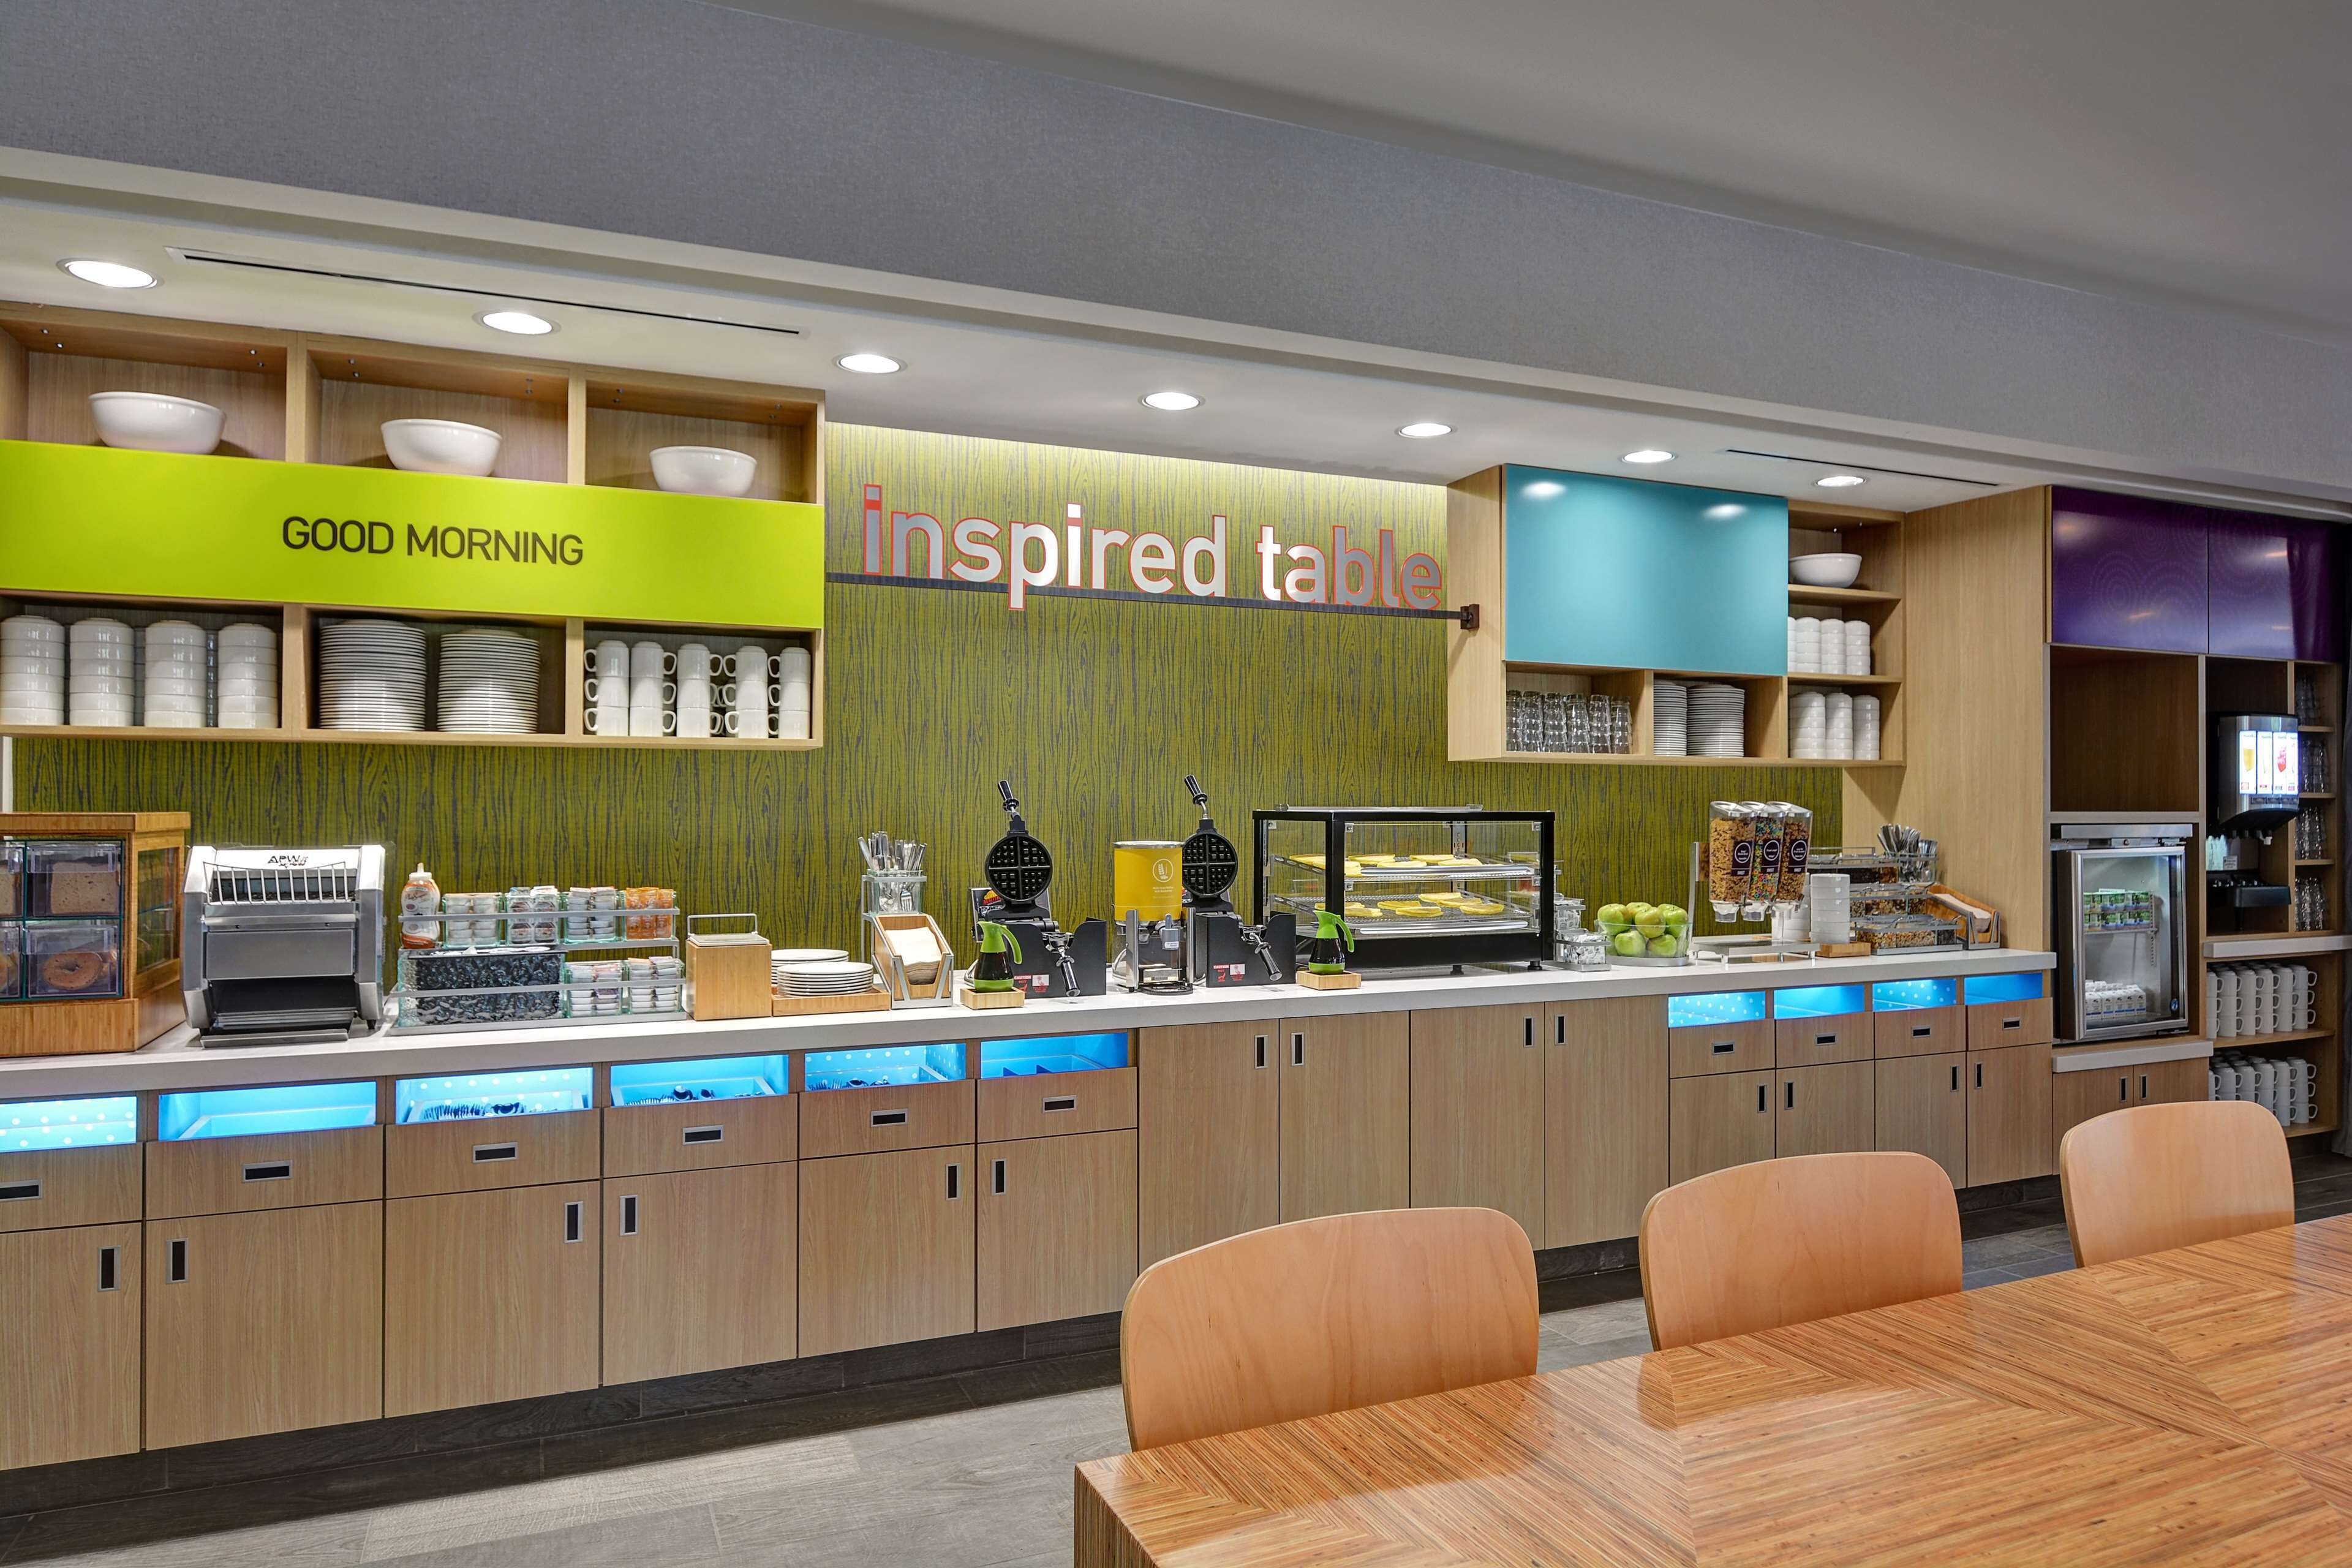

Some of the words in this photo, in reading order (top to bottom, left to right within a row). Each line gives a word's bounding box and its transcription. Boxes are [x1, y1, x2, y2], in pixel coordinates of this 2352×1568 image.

[283, 516, 394, 554] GOOD
[407, 524, 584, 565] MORNING
[864, 484, 1226, 611] inspired
[1255, 525, 1442, 610] table
